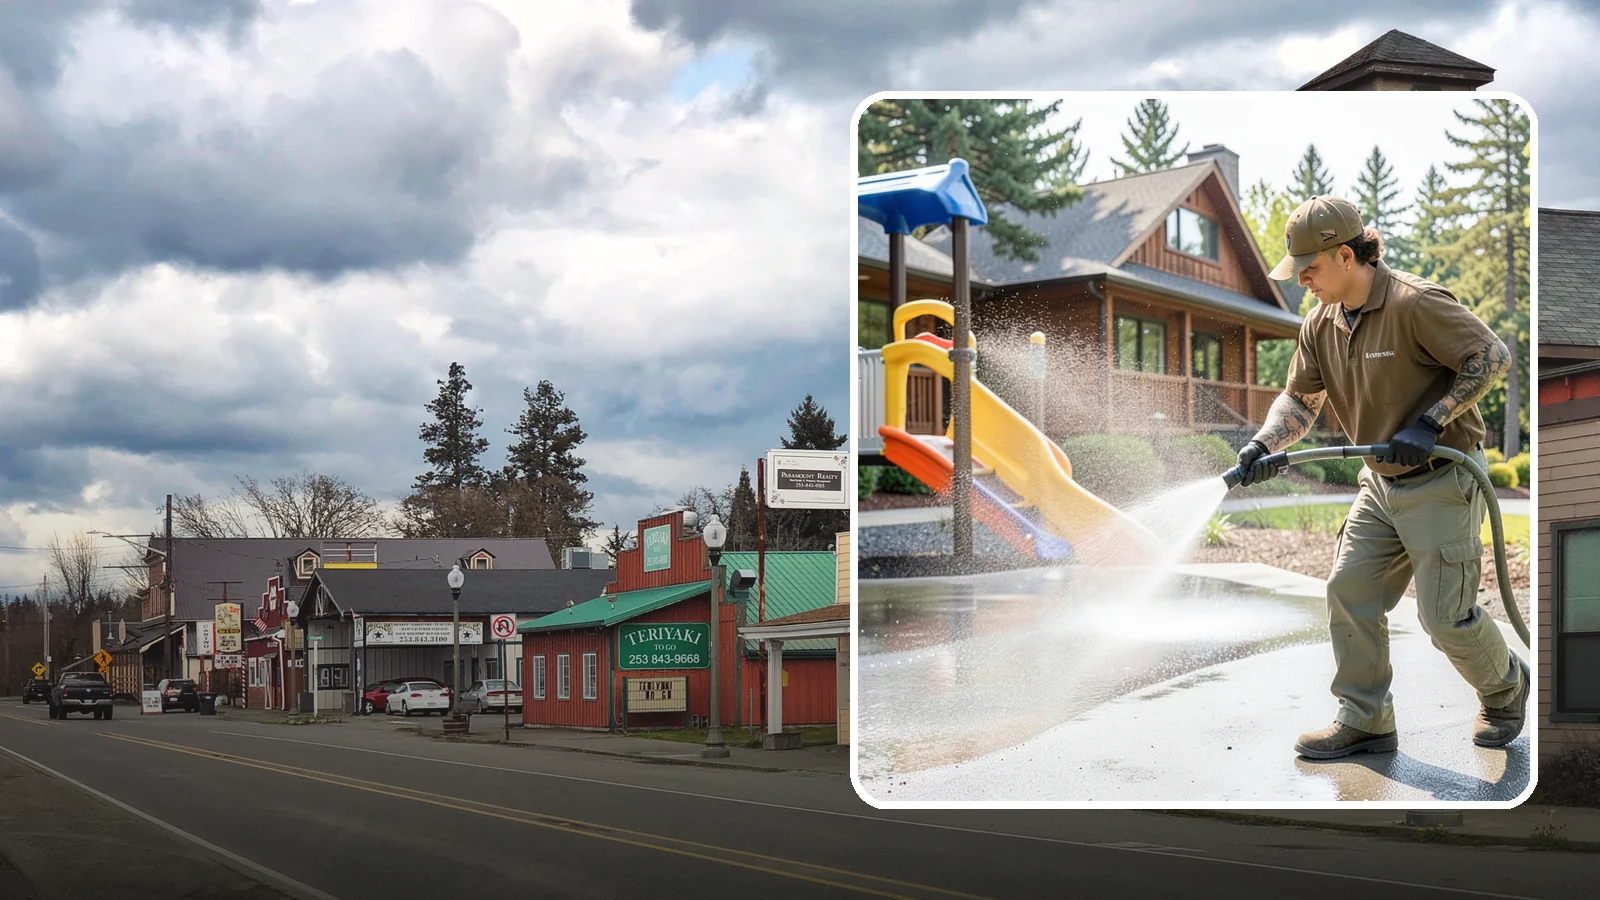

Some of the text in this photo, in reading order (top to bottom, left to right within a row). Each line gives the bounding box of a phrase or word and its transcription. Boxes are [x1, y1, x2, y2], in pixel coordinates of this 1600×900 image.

[781, 471, 839, 480] PARAMOUNT REALTY
[625, 627, 702, 646] TERIYAKI
[628, 653, 700, 665] 253 843-9668
